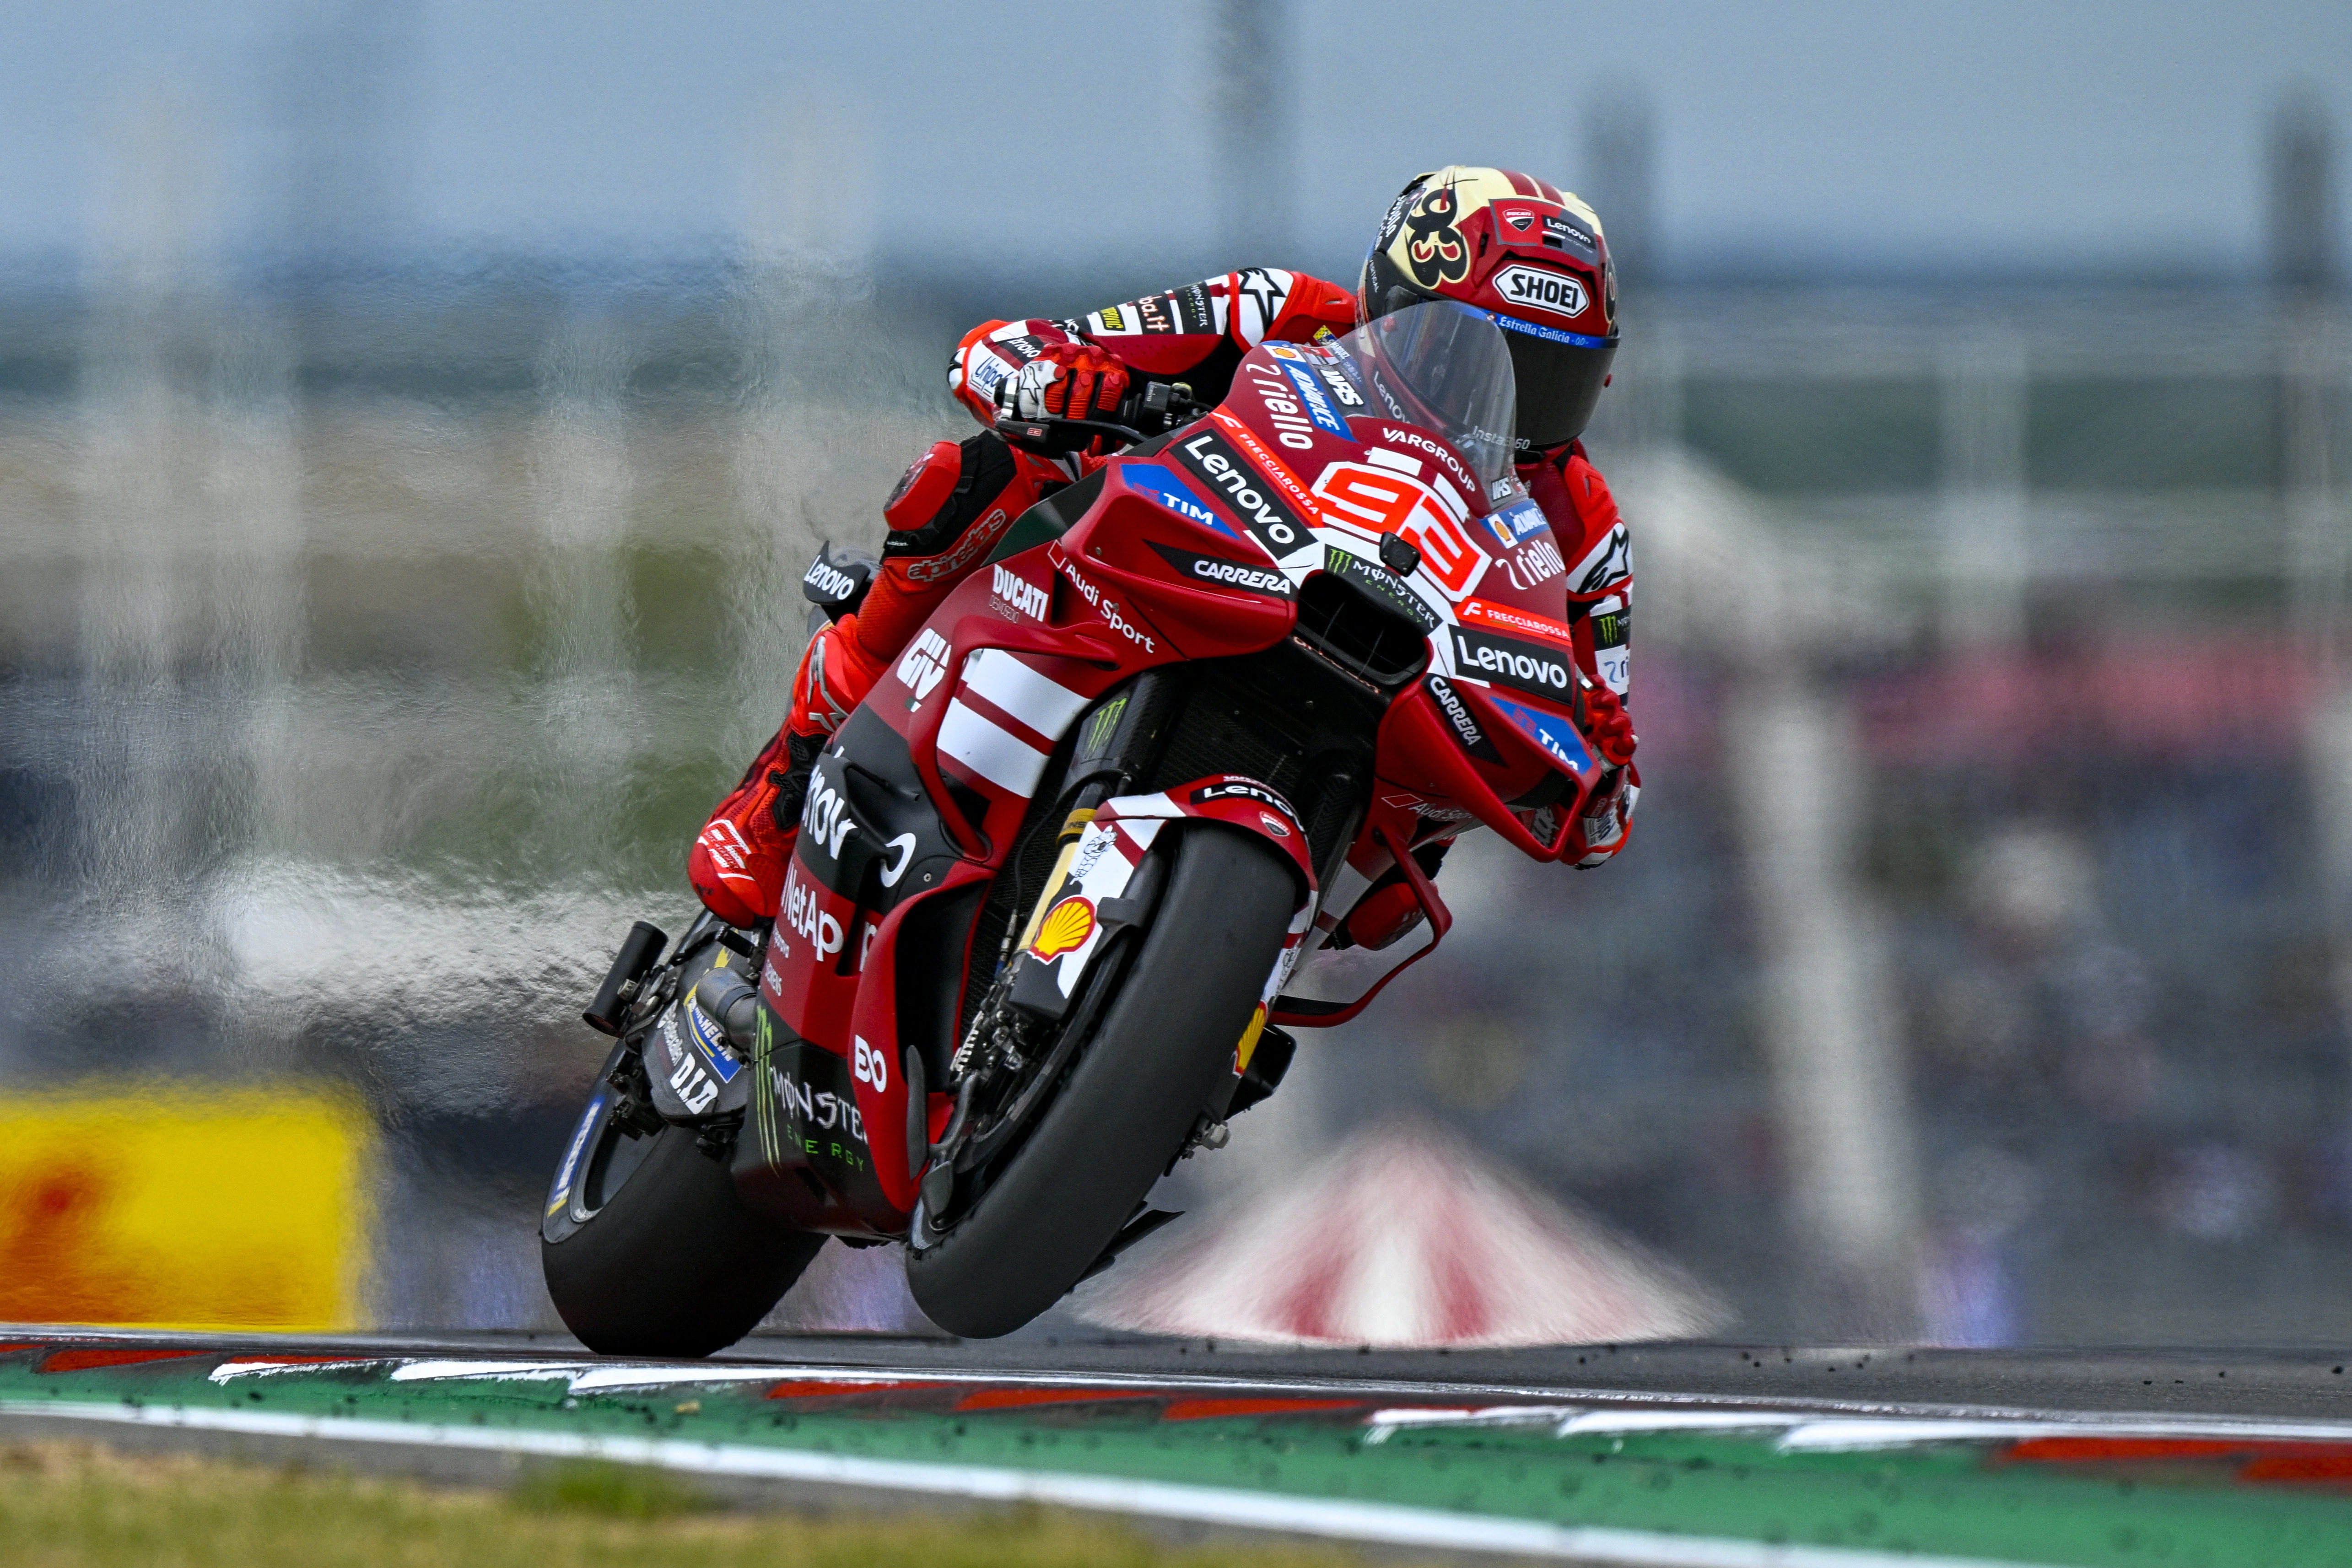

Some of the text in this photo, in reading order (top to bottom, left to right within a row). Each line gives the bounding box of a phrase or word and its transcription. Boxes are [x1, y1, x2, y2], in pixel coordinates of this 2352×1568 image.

[1546, 218, 1591, 243] Lenovo
[1510, 274, 1579, 309] SHOEI
[1330, 341, 1350, 360] MARQUEZ
[1499, 316, 1537, 334] Estrella
[1538, 327, 1570, 343] Galicia
[1284, 364, 1340, 431] ADVANCE
[1320, 369, 1364, 405] WRS
[1253, 378, 1314, 449] riello
[1239, 433, 1319, 516] FRECCIAROSSA
[1382, 427, 1476, 492] VARGROUP
[1163, 493, 1214, 525] TIM
[1185, 436, 1295, 544] Lenovo
[804, 555, 855, 600] Lenovo
[993, 564, 1049, 622] DUCATI
[1194, 560, 1290, 594] CARRERA
[1353, 561, 1435, 628] MONSTER
[1065, 564, 1155, 653] Audi Sport
[1487, 610, 1570, 639] FRECCIAROSSA
[1457, 635, 1567, 688] Lenovo
[1430, 677, 1481, 745] CARRERA
[1539, 728, 1578, 771] TIM
